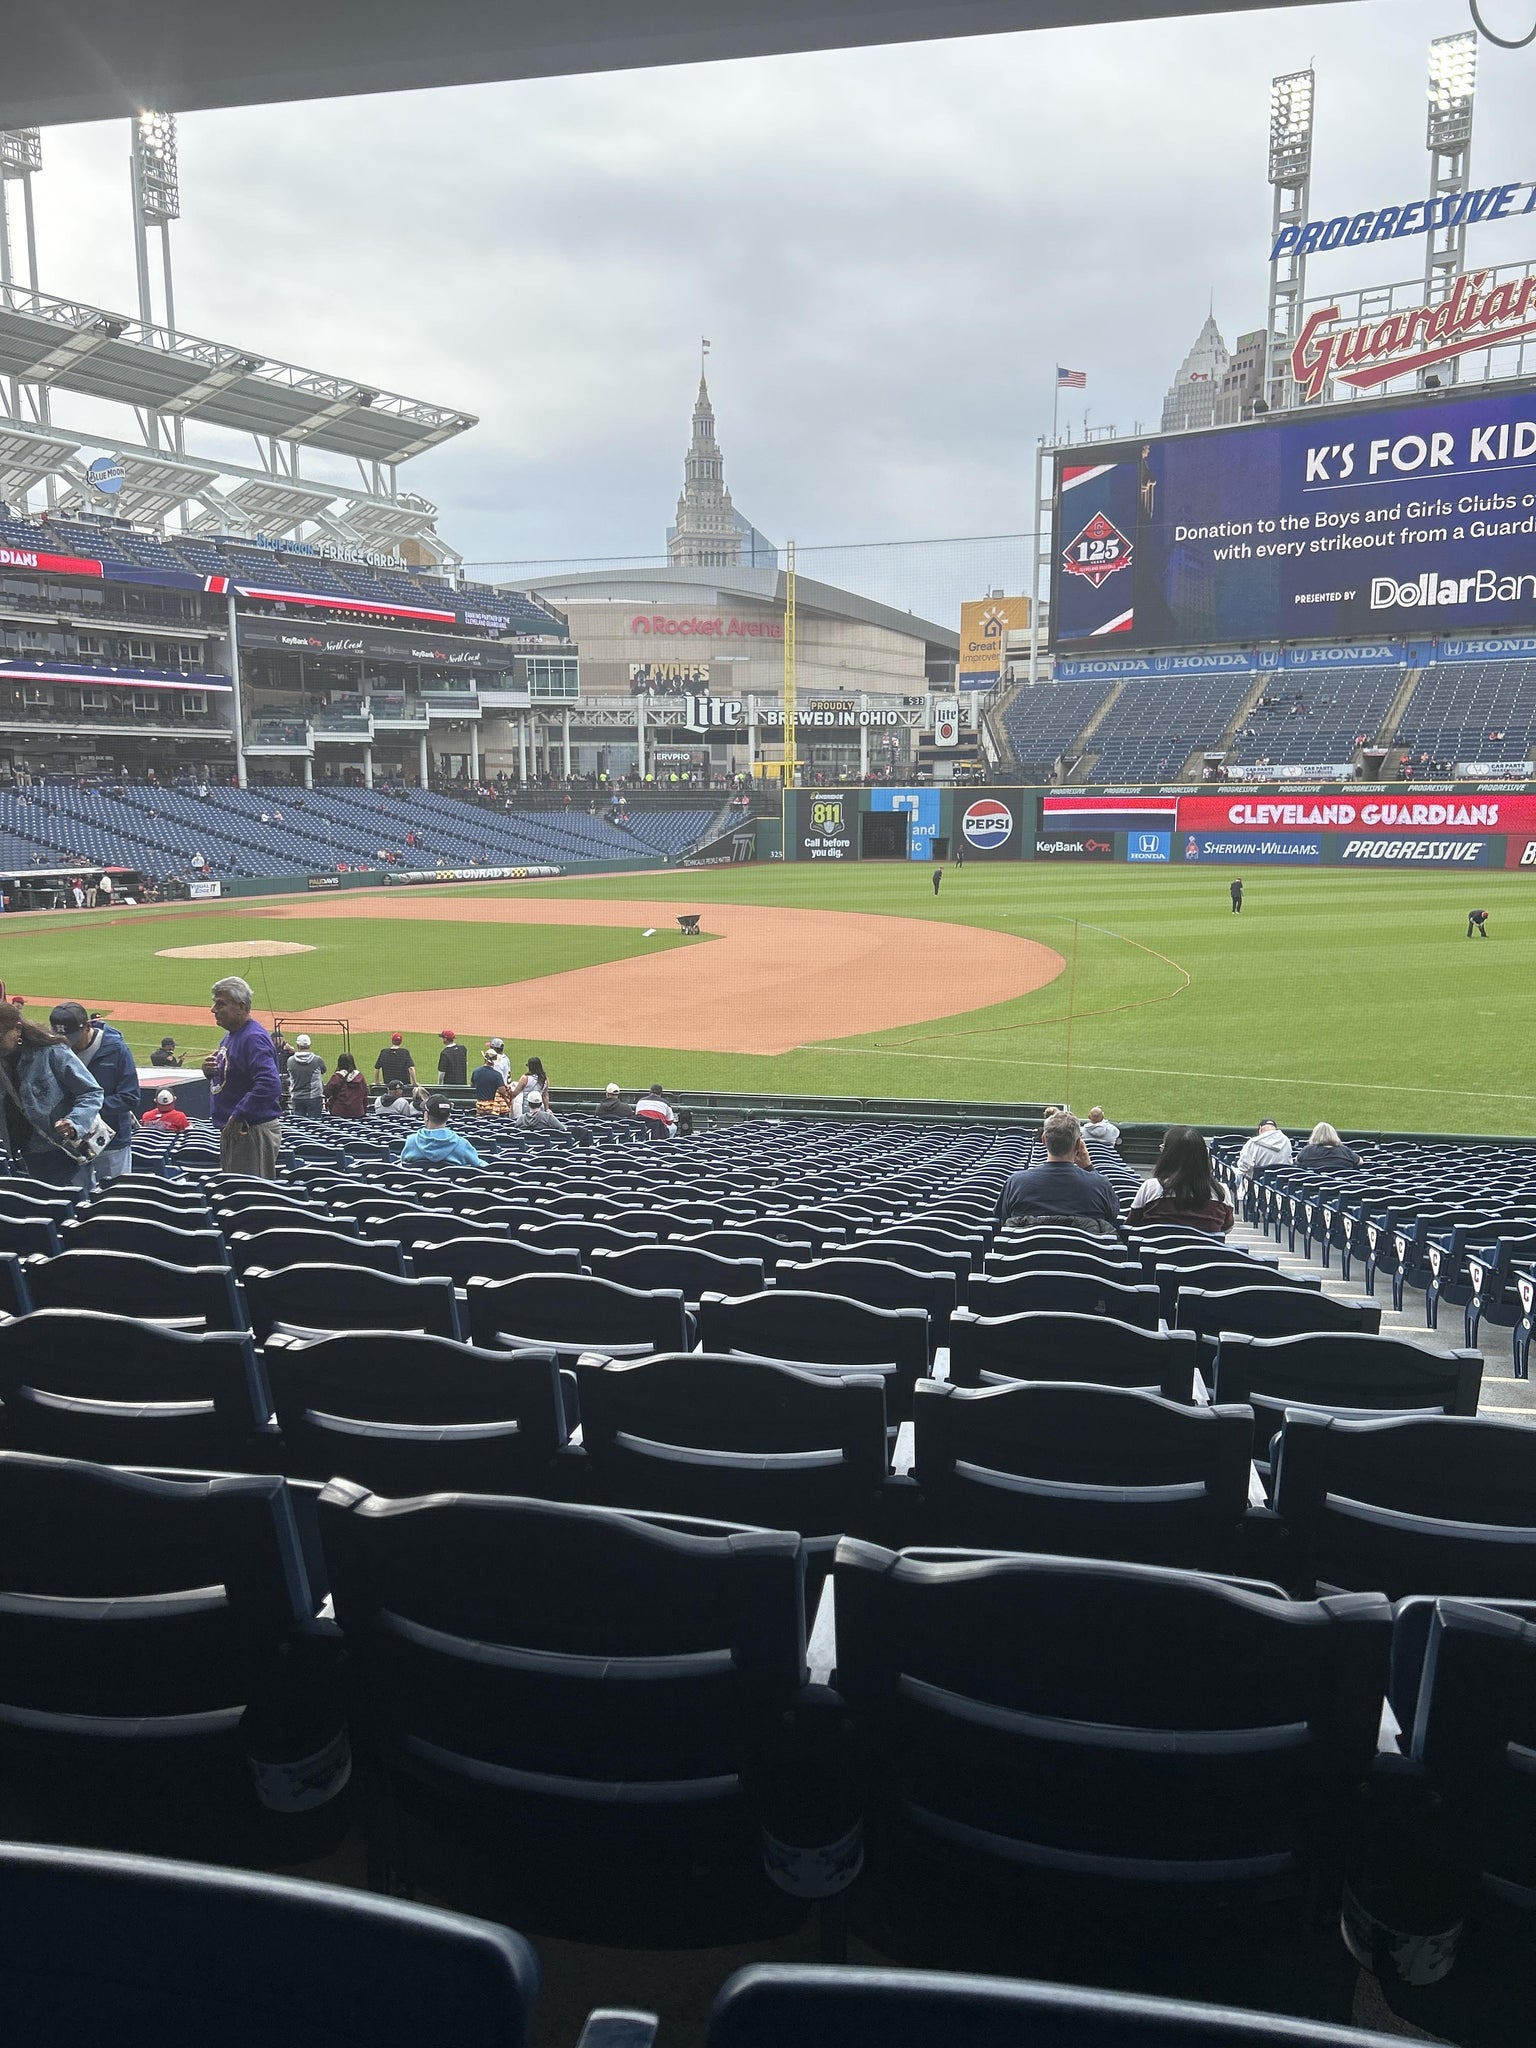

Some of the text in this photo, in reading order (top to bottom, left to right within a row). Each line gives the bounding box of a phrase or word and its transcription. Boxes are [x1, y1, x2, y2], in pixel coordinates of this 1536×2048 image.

[1269, 182, 1521, 261] PROGRESSIVE
[1306, 421, 1536, 482] K'S FOR KID
[89, 468, 125, 483] BLUE MOON
[1175, 521, 1253, 541] Donation
[1257, 519, 1276, 533] to
[1280, 514, 1310, 531] the
[1315, 511, 1360, 529] Boys
[1364, 503, 1401, 523] and
[1406, 499, 1452, 519] Girls
[1458, 493, 1517, 513] Clubs
[1077, 539, 1120, 562] 125
[1214, 542, 1251, 561] with
[1256, 541, 1306, 557] every
[1310, 530, 1395, 553] strikeout
[1401, 528, 1447, 545] from
[1453, 526, 1465, 540] a
[0, 549, 38, 567] DIANS
[1294, 592, 1342, 604] PRESENTED
[1344, 591, 1357, 601] BY
[653, 615, 783, 638] Rocket Arena
[281, 635, 309, 645] KeyBank
[968, 641, 996, 652] Great
[411, 649, 435, 658] KeyBank
[1310, 646, 1394, 661] HONDA
[1079, 659, 1150, 673] HONDA
[1172, 654, 1248, 668] HONDA
[629, 663, 710, 681] PLAYOFFS
[810, 701, 855, 711] PROUDLY
[682, 695, 743, 734] Lite
[767, 710, 899, 726] BREWED IN OHIO
[937, 709, 957, 723] Lite
[653, 753, 690, 761] ERVPRO
[1278, 785, 1322, 793] PROGRESSIVE
[1407, 784, 1455, 792] PROGRESSIVE
[1476, 784, 1527, 792] PROGRESSIVE
[814, 803, 840, 824] 811
[1229, 804, 1499, 826] CLEVELAND GUARDIANS
[912, 823, 936, 835] and
[966, 818, 1010, 830] PEPSI
[804, 838, 850, 847] Call before
[1036, 841, 1084, 853] KeyBank
[811, 847, 844, 858] you dig.
[1342, 840, 1483, 860] PROGRESSIVE
[455, 867, 511, 879] CONRAD'S
[1523, 1285, 1529, 1302] C
